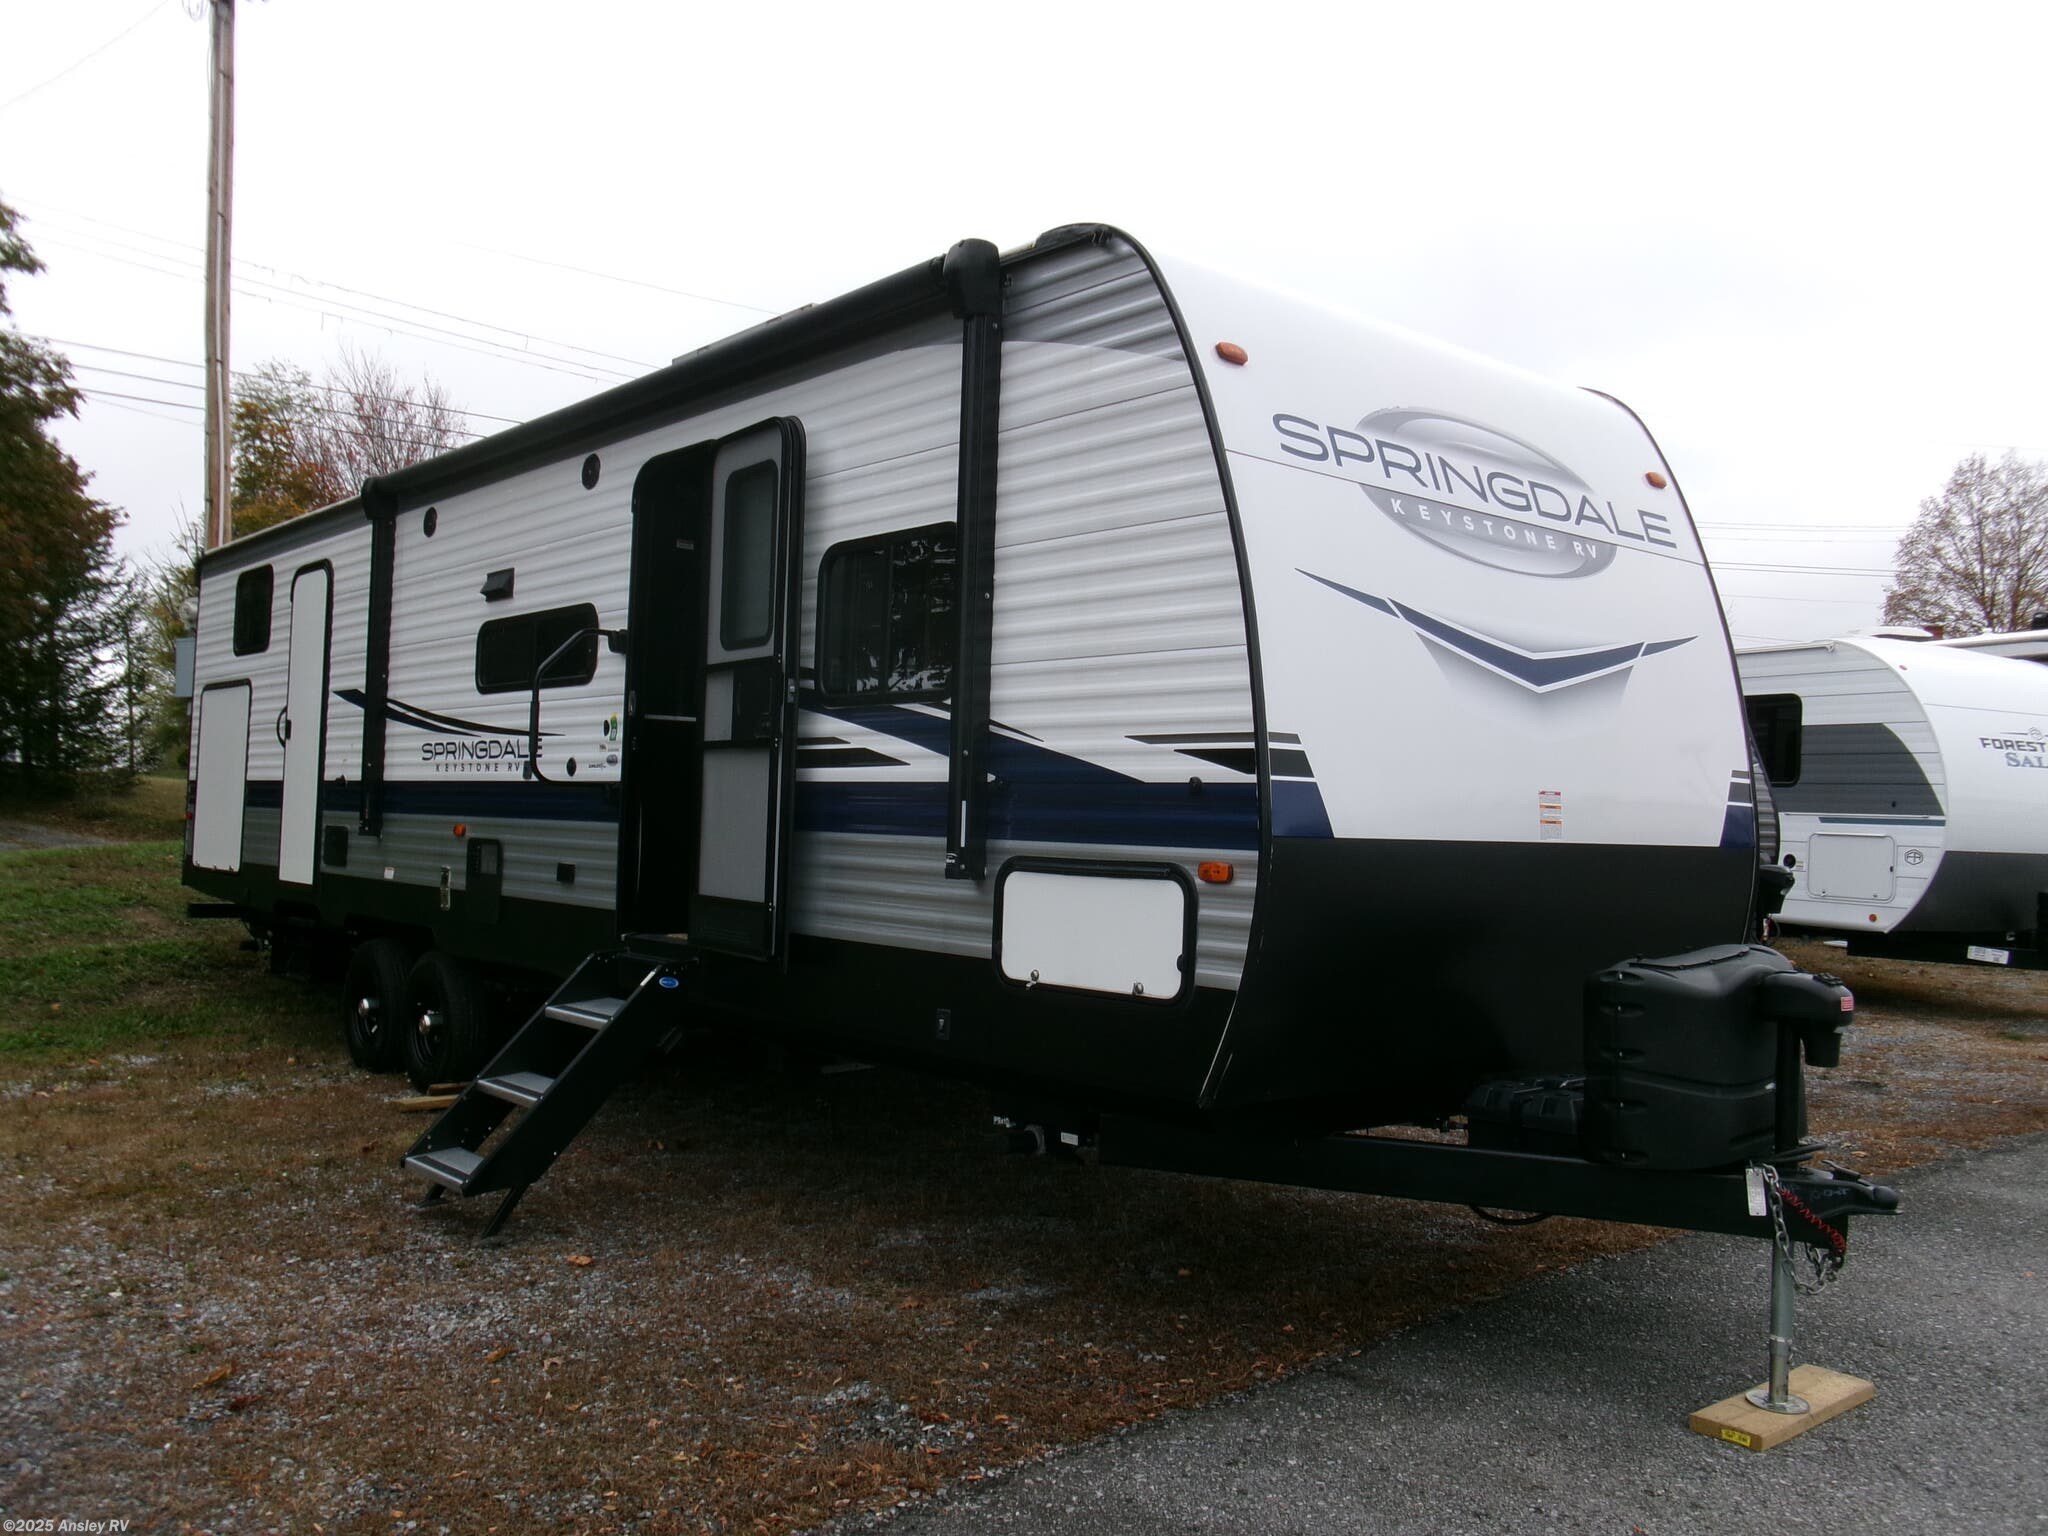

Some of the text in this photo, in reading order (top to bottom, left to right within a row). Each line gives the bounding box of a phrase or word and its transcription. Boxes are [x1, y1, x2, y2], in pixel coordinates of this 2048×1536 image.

[1272, 413, 1678, 549] SPRINGDALE
[1390, 497, 1598, 560] KEYSTONE RV
[1979, 737, 2046, 753] FOREST
[435, 761, 520, 773] KEYSTONE RV
